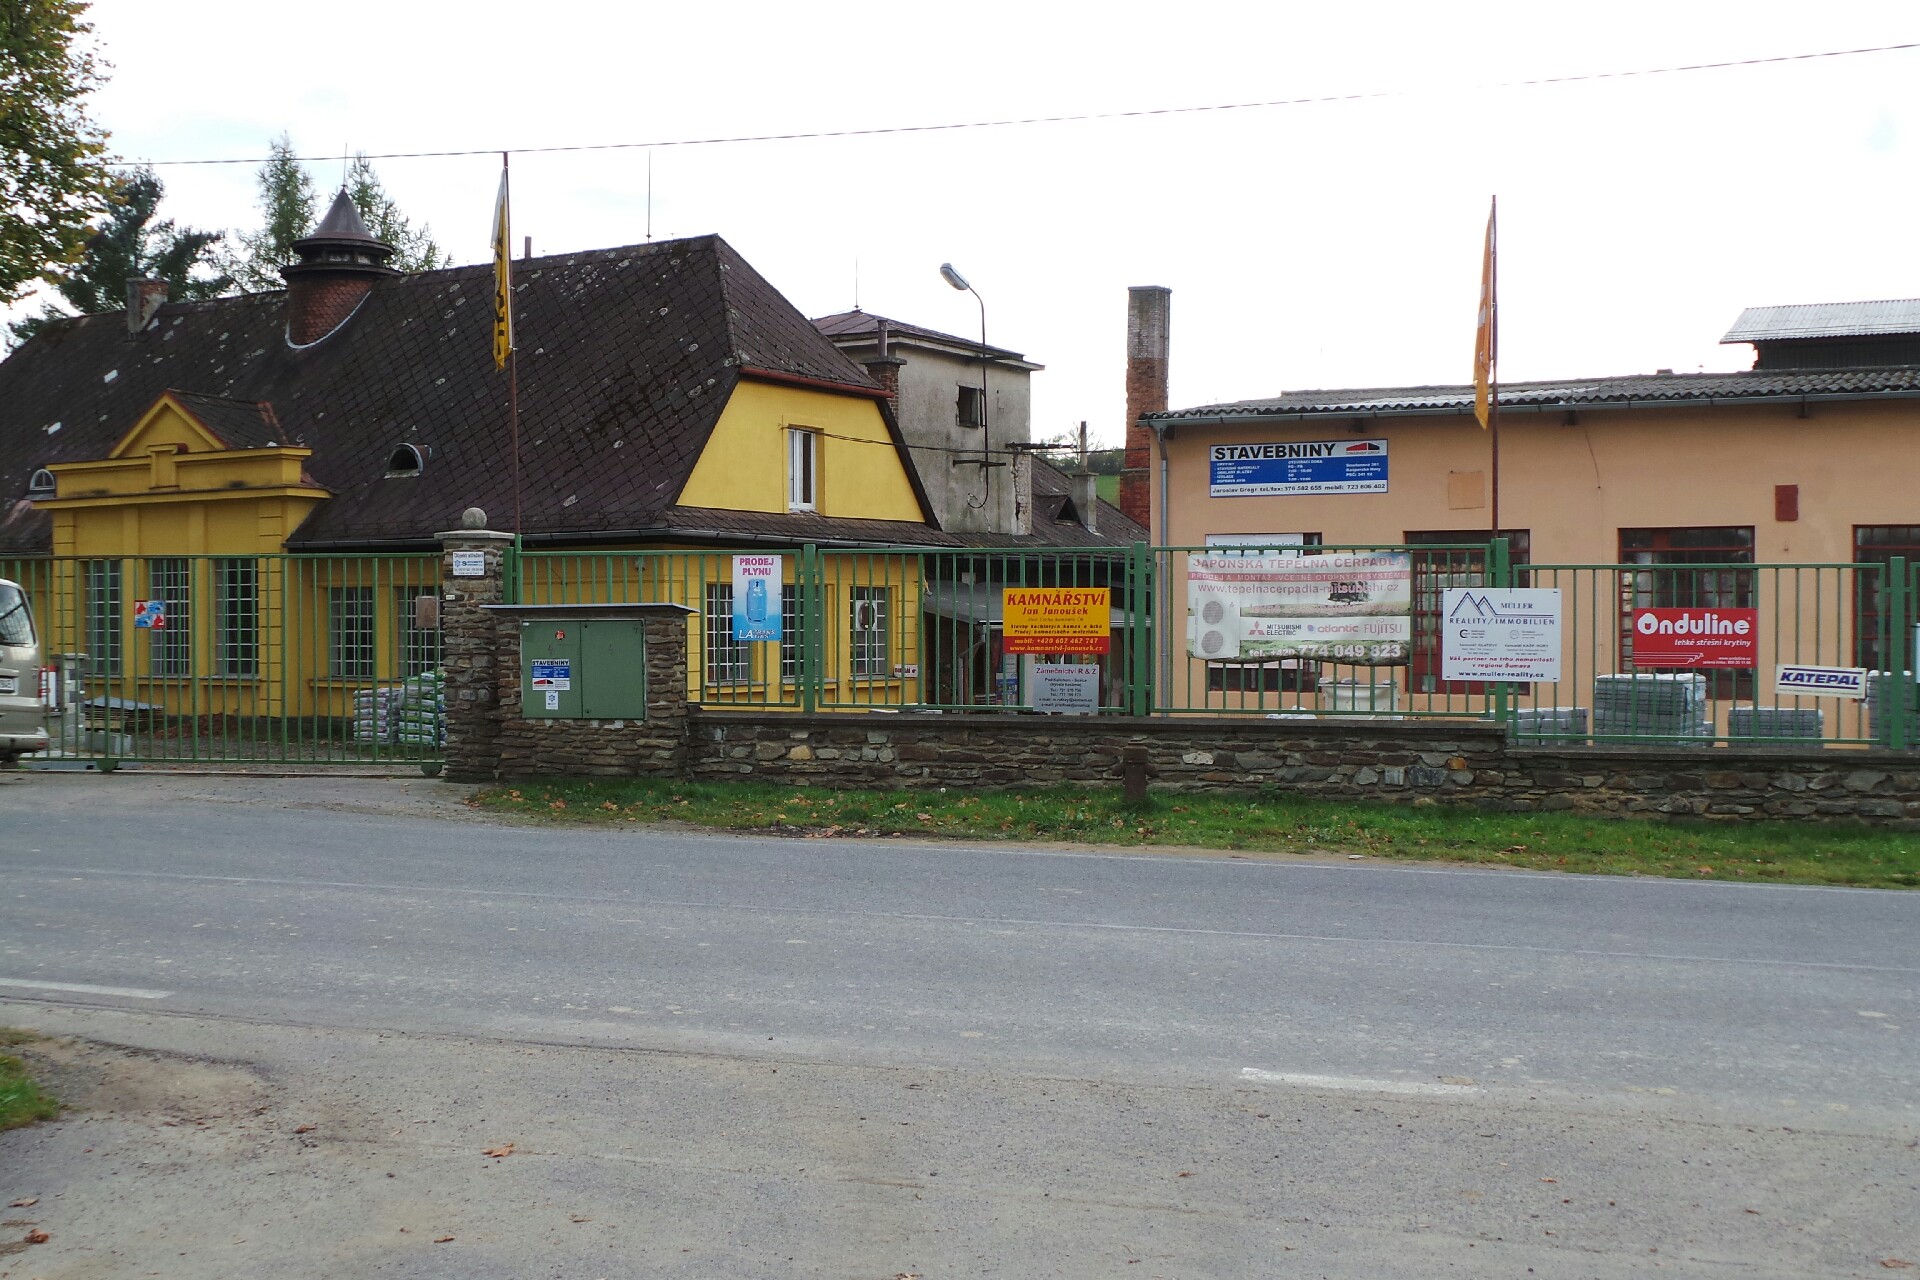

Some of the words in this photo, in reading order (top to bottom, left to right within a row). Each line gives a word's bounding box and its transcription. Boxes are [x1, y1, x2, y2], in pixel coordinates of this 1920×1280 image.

[1214, 443, 1336, 460] STAVEBNINY
[739, 557, 774, 566] PRODEJ
[742, 567, 772, 576] PLYNU
[1191, 572, 1224, 581] PRODEJ
[1226, 573, 1232, 581] A
[1007, 590, 1106, 606] KAMNÁŘSTVÍ
[1500, 601, 1534, 609] MÜLLER
[1022, 607, 1039, 615] Jan
[1043, 606, 1089, 615] Janoušek
[1317, 623, 1359, 633] atlantic
[1637, 612, 1751, 635] Onduline
[1364, 623, 1402, 635] FUJITSU
[738, 629, 754, 639] LA
[1014, 637, 1035, 645] mobil:
[1036, 637, 1054, 645] +420
[1055, 637, 1068, 645] 602
[1069, 637, 1083, 645] 462
[1674, 638, 1696, 646] lehké
[1695, 638, 1722, 646] střešní
[1723, 638, 1752, 648] krytiny
[1009, 645, 1104, 653] www.kamnarstvi-janousek.cz
[1270, 648, 1296, 657] +420
[1297, 644, 1329, 657] 774
[1334, 644, 1365, 657] 049
[1370, 644, 1401, 657] 823
[1036, 667, 1077, 675] Zámečnictví
[1458, 671, 1545, 679] www.muller-reality.cz
[1780, 672, 1860, 686] KATEPAL
